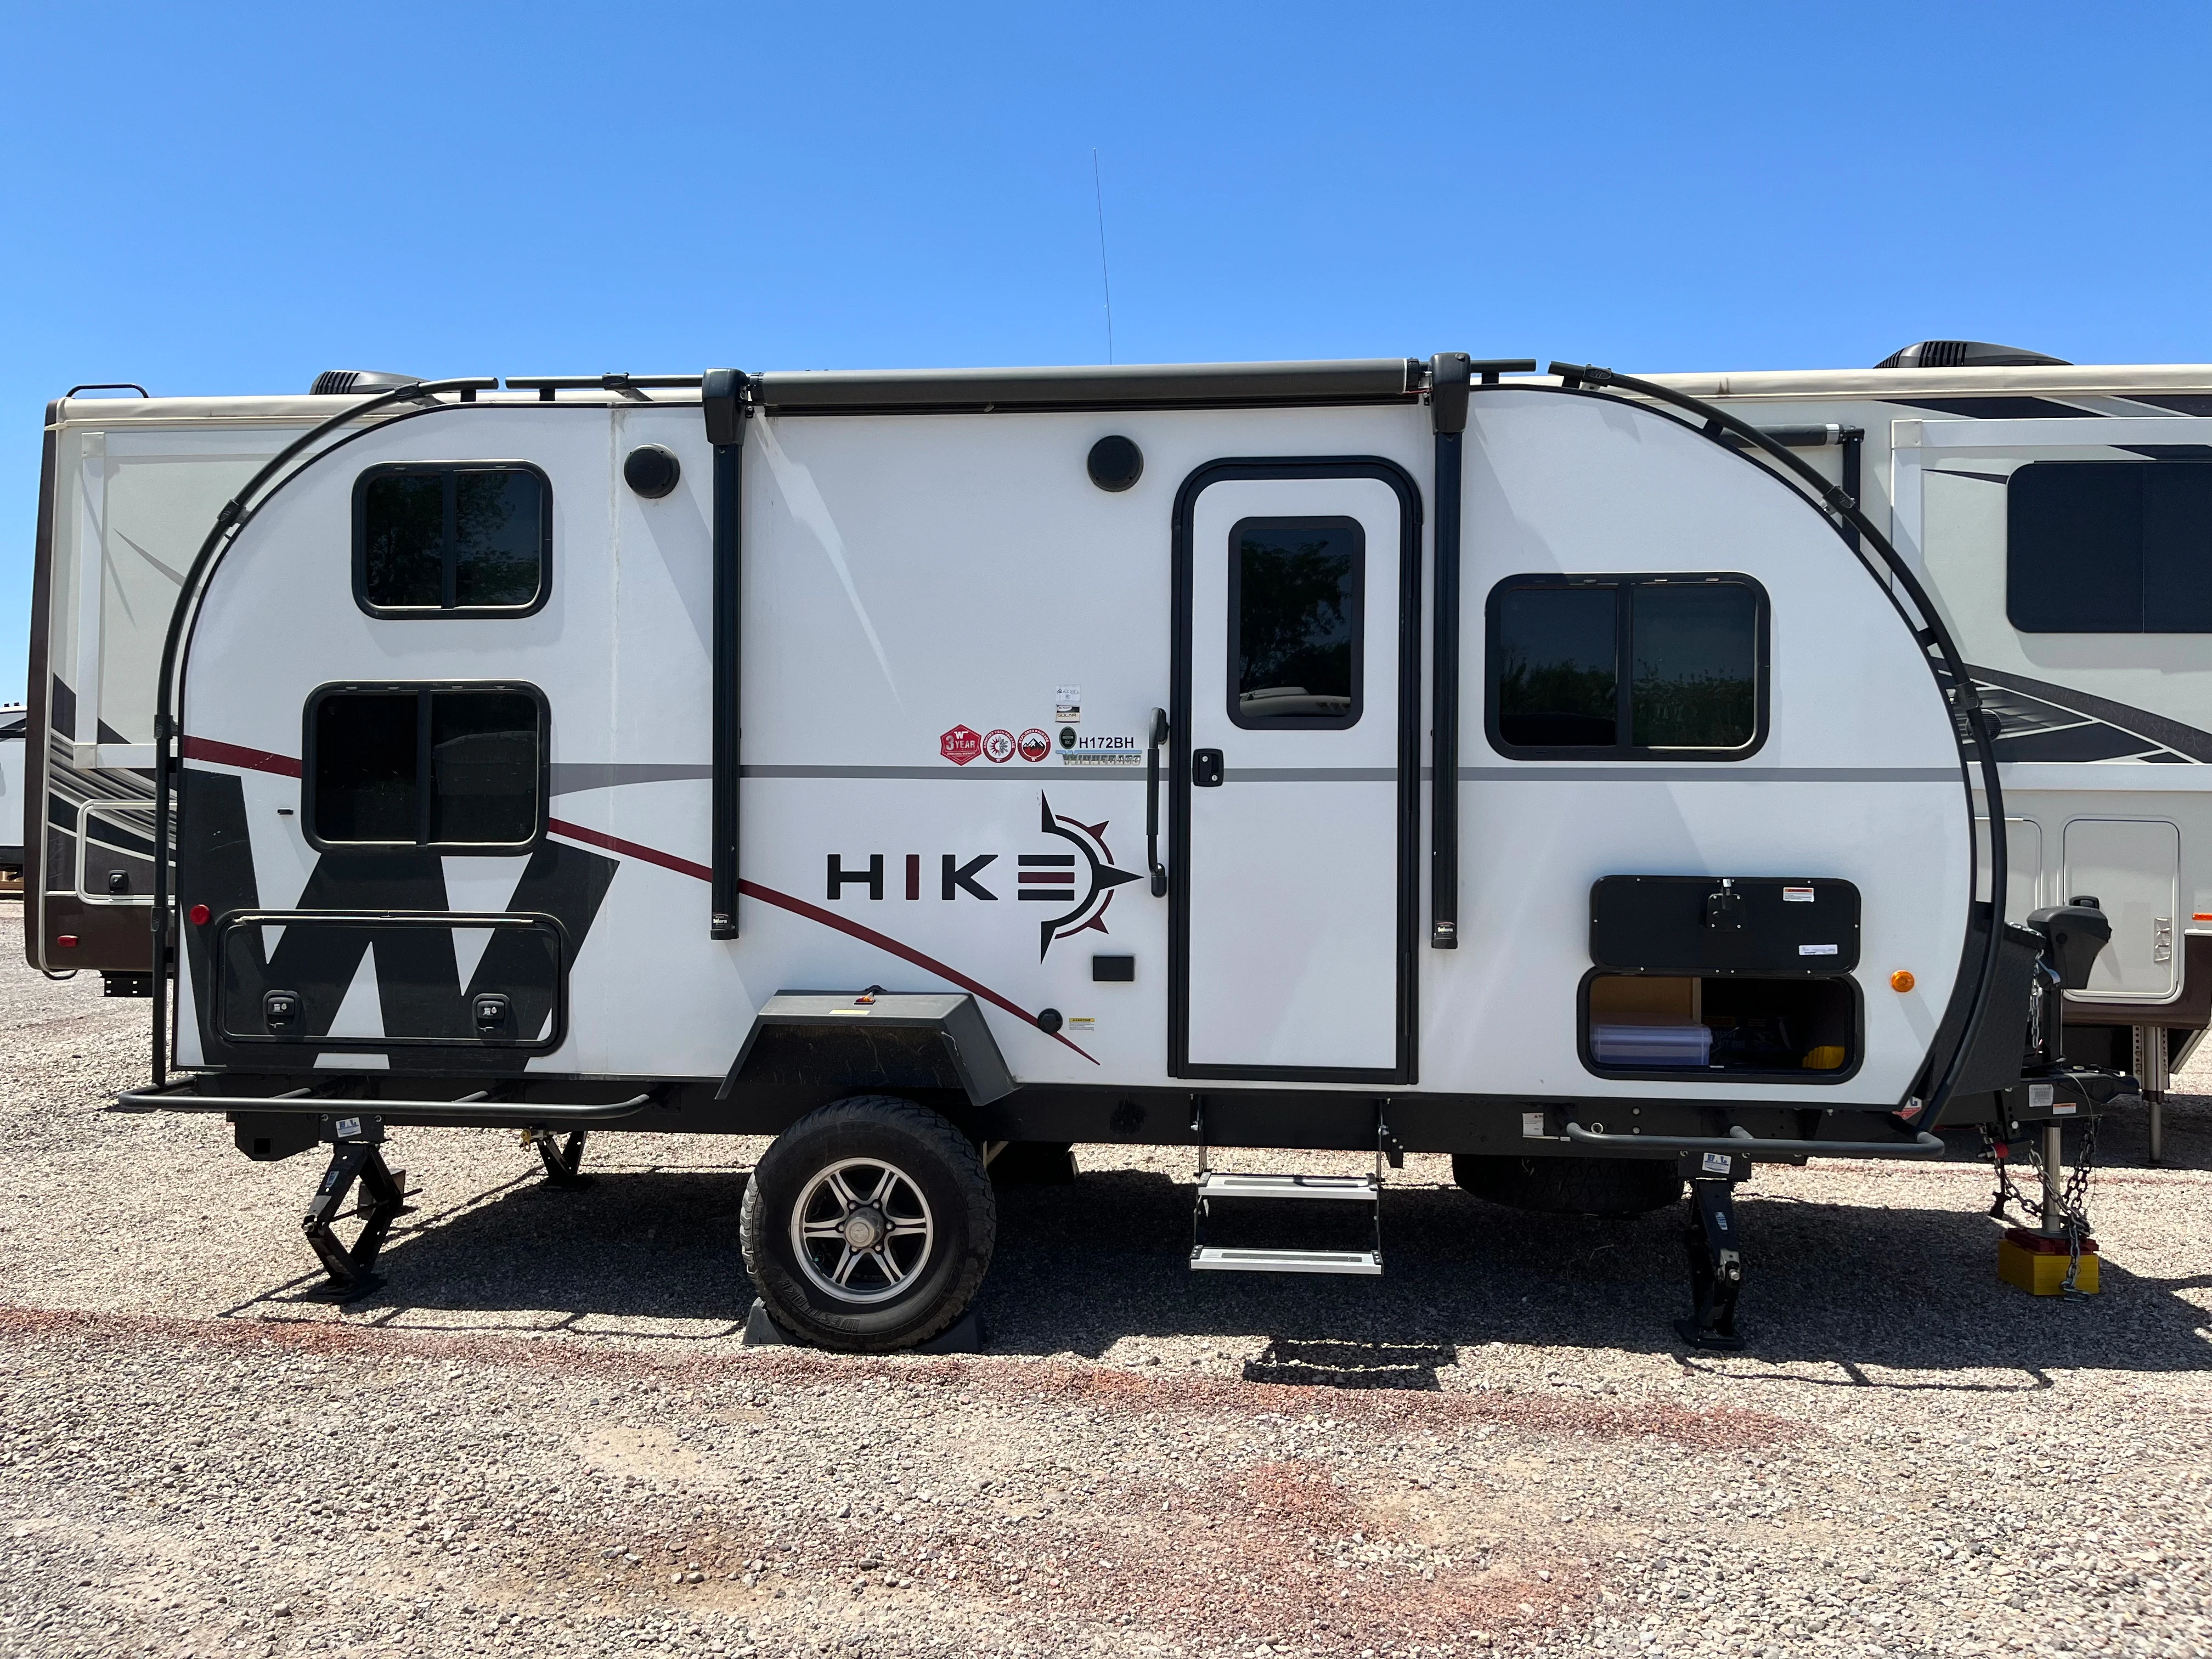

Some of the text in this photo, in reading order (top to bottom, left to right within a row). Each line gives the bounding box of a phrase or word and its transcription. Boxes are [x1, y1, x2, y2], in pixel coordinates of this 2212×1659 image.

[945, 735, 975, 751] 3 YEAR
[1018, 729, 1049, 743] EXPLORER PACKAGE
[1079, 737, 1134, 748] H172BH
[1056, 750, 1142, 766] WINNEBAGO
[827, 854, 1075, 900] HIKE
[780, 1279, 861, 1333] WESTLAKE
